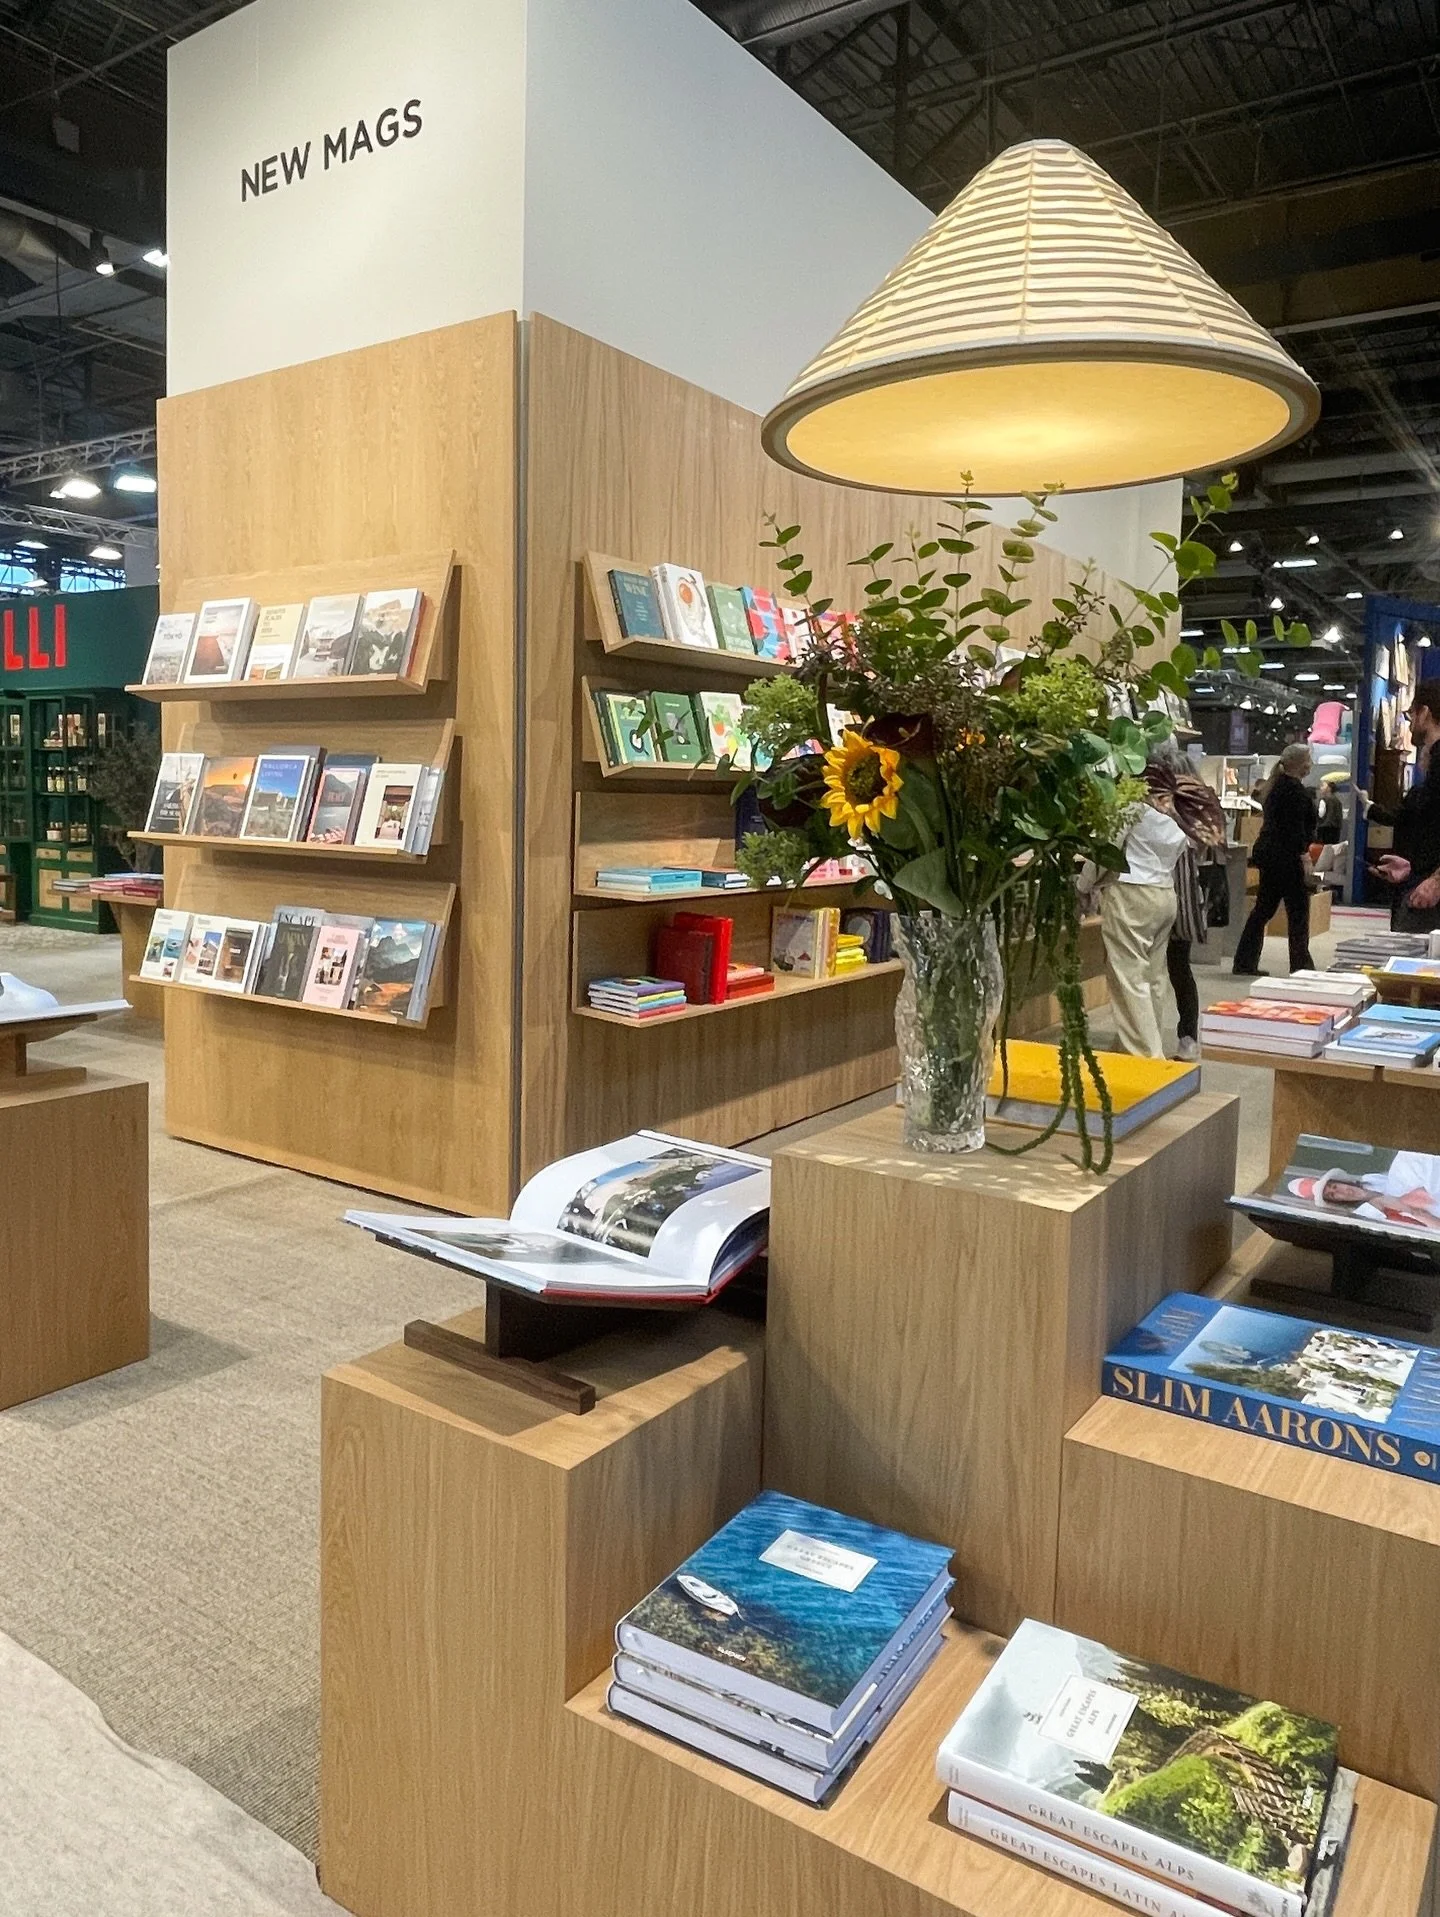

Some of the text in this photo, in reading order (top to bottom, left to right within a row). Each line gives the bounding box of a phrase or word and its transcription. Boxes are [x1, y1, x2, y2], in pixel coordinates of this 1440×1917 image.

[241, 99, 422, 202] NEW MAGS
[3, 604, 66, 670] LLI
[1112, 1366, 1401, 1467] SLIM AARONS
[990, 1828, 1037, 1855] GREAT
[1043, 1851, 1106, 1887] ESCAPES
[1113, 1882, 1162, 1912] LATIN
[1028, 1803, 1194, 1881] GREAT ESCAPES ALPS
